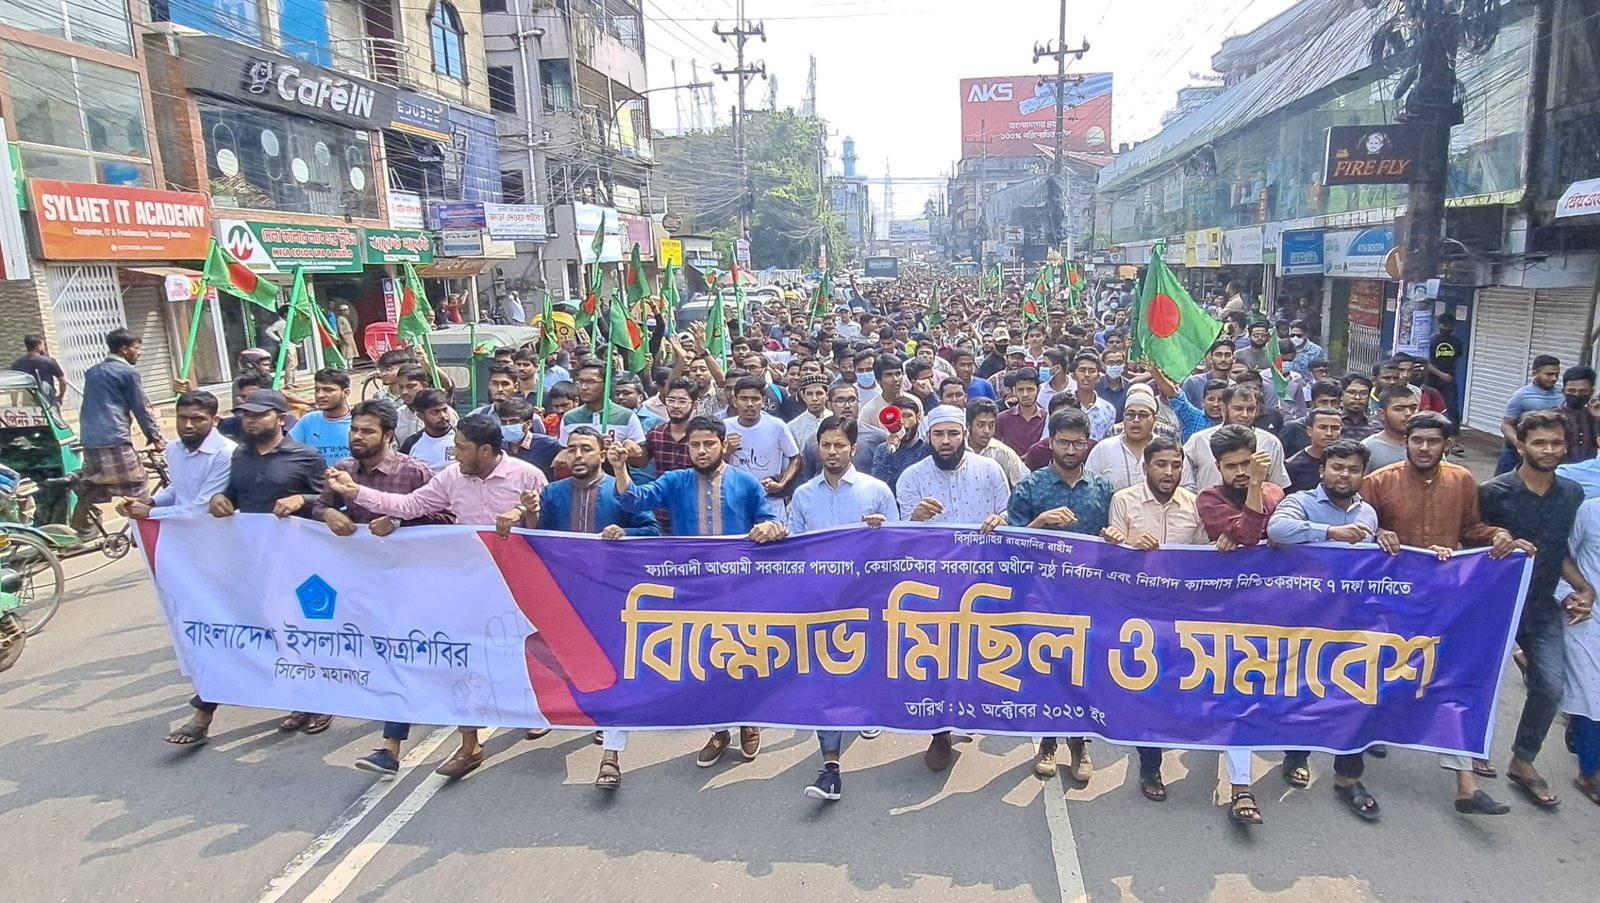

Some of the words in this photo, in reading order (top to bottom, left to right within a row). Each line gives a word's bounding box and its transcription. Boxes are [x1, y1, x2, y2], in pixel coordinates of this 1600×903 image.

[967, 83, 1013, 102] AKS
[1000, 132, 1022, 140] ১০০%
[41, 193, 110, 223] SYLHET
[113, 199, 131, 224] IT
[135, 200, 205, 228] ACADEMY
[1005, 537, 1045, 550] রাহমানির
[645, 559, 701, 577] ফ্যাসিবাদী
[704, 557, 752, 576] আওয়ামী
[755, 560, 805, 575] সরকারের
[864, 555, 936, 575] কেয়ারটেকার
[940, 560, 994, 575] সরকারের
[998, 556, 1033, 575] অধীনে
[1061, 562, 1103, 580] নির্বাচন
[1106, 572, 1131, 584] এবং
[1136, 572, 1181, 589] নিরাপদ
[1184, 578, 1232, 591] ক্যাম্পাস
[1236, 573, 1323, 593] নিশ্চিতকরণসহ
[1326, 580, 1336, 593] ৭
[1340, 579, 1365, 594] দফা
[1367, 576, 1413, 595] দাবিতে
[183, 619, 279, 651] বাংলাদেশ
[283, 620, 364, 658] ইসলামী
[371, 629, 472, 669] ছাত্রশিবির
[620, 582, 870, 682] বিক্ষোভ
[882, 580, 1091, 693] মিছিল
[1107, 617, 1159, 691] ও
[1174, 619, 1442, 705] সমাবেশ
[274, 657, 317, 681] সিলেট
[322, 666, 371, 687] মহানগর
[905, 697, 945, 717] তারিখ
[957, 701, 976, 718] ১২
[981, 701, 1038, 719] অক্টোবর
[1042, 703, 1085, 719] ২০২৩
[1088, 705, 1107, 727] ইং
